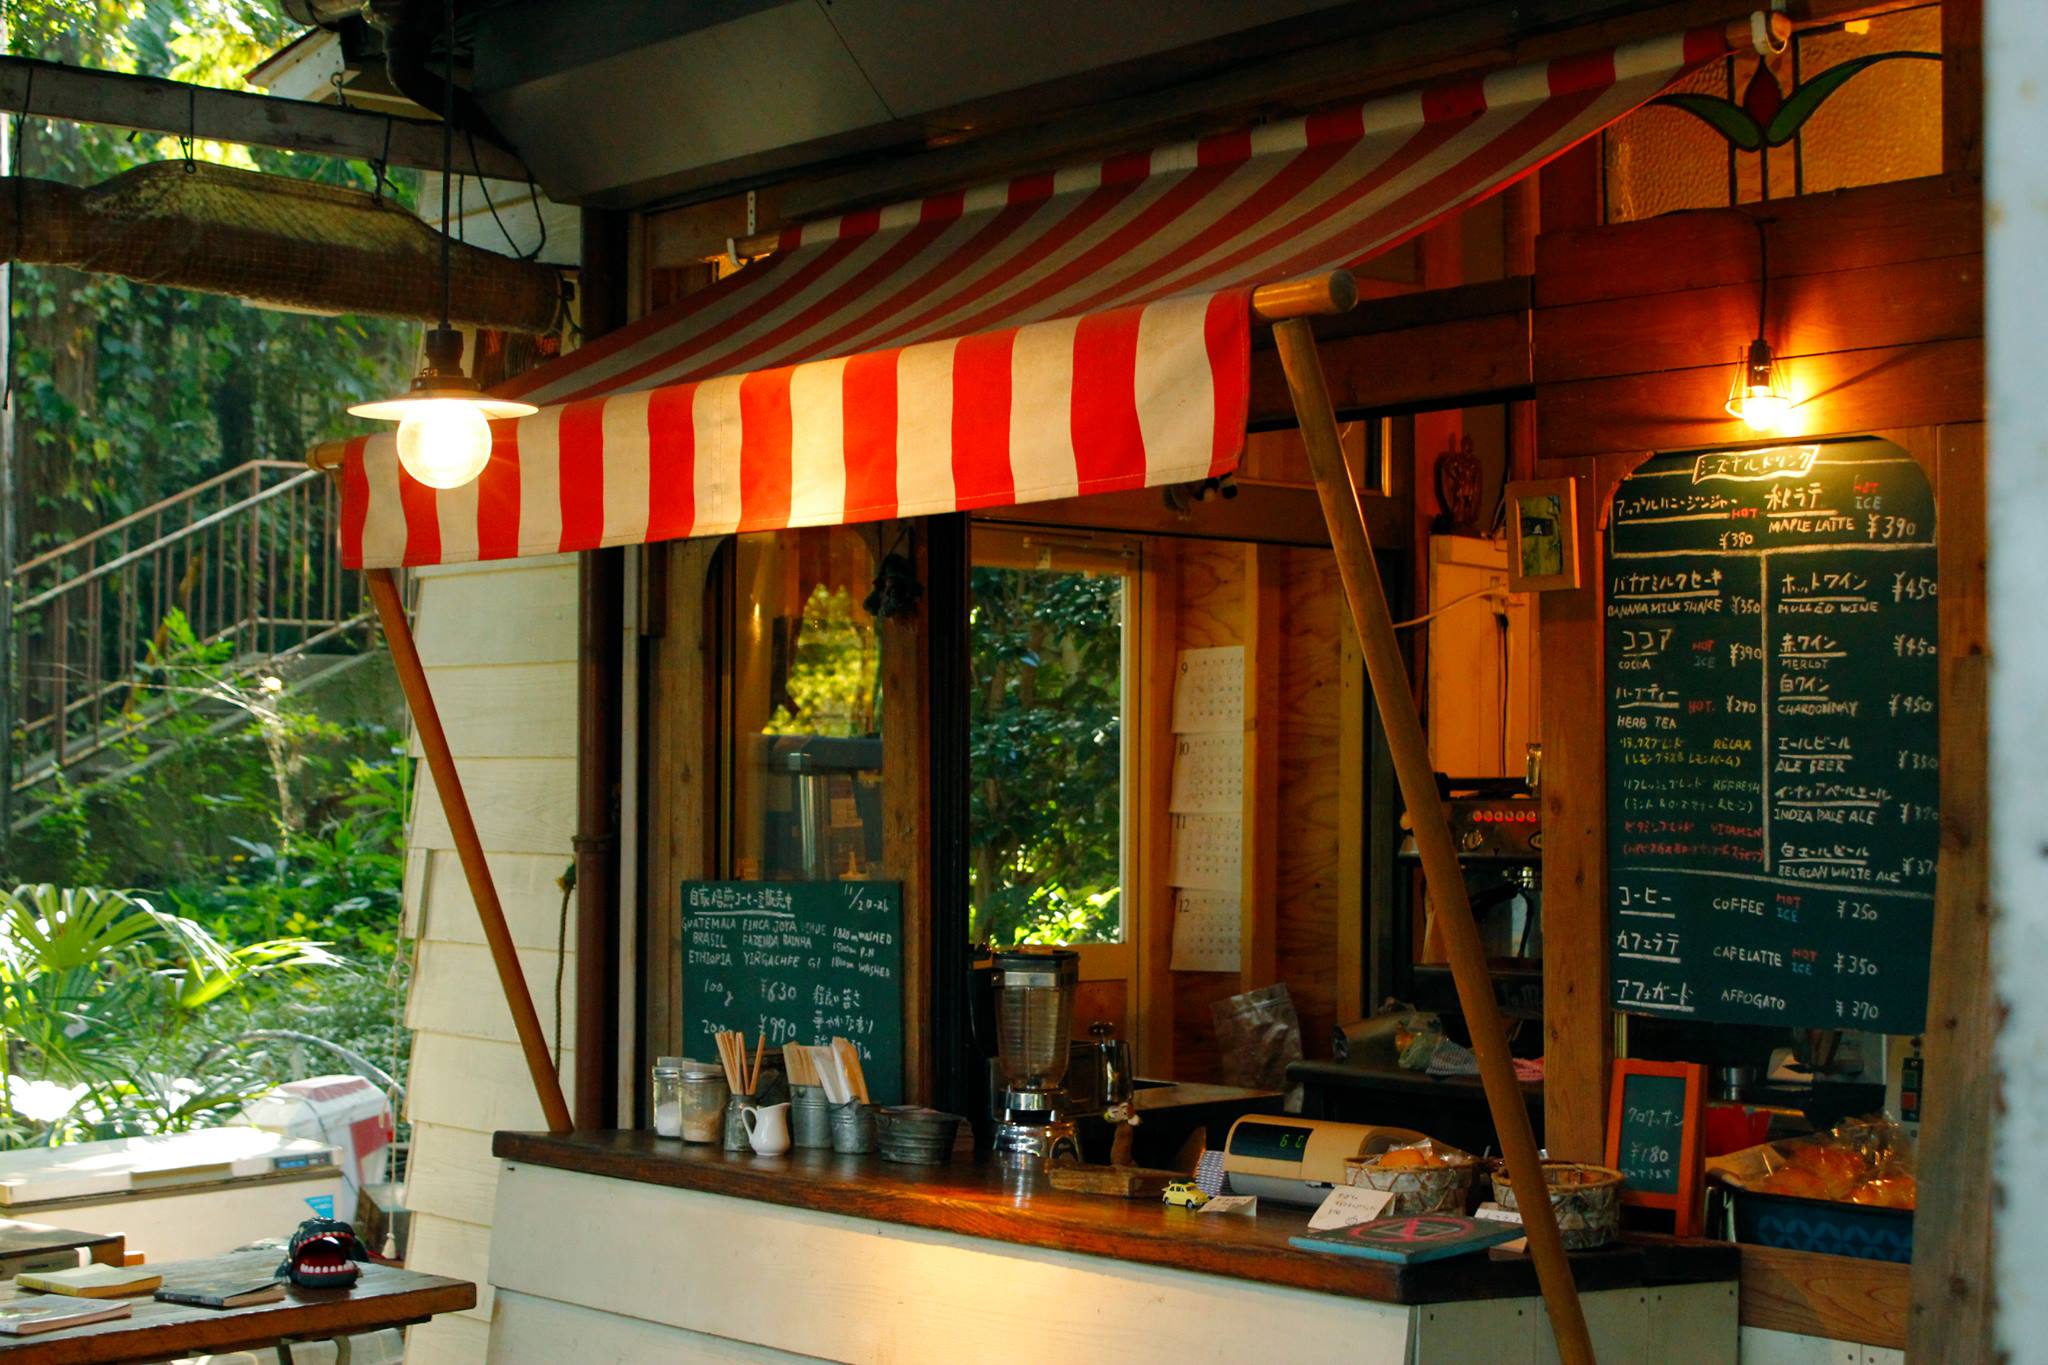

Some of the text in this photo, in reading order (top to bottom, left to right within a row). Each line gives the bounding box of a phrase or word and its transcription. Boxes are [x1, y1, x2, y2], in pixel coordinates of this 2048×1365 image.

[1854, 496, 1882, 510] ICE
[1731, 508, 1759, 520] HOT
[1768, 516, 1856, 534] MAPLE LATTE
[1866, 513, 1917, 539] ¥390
[1719, 531, 1754, 549] ¥390
[1613, 568, 1723, 594] バナナミルクセーキ
[1781, 571, 1868, 595] ホットワイン
[1777, 601, 1879, 615] MULLED WINE
[1622, 628, 1674, 651] ココア
[1692, 639, 1715, 652] HOT
[1780, 632, 1838, 653] 赤ワイン
[1781, 658, 1829, 670] MERLOT
[1780, 673, 1830, 693] 白ワイン
[1617, 715, 1678, 729] HERB TEA
[1713, 737, 1753, 750] RELAX
[1775, 759, 1846, 774] ALE BEER
[1773, 808, 1877, 826] INDIA PALE ALE
[1778, 864, 1901, 883] BELGIAN WHITE ALE
[1902, 857, 1937, 876] ¥37
[1618, 885, 1672, 906] コーヒー
[1178, 898, 1190, 913] 12
[1712, 897, 1765, 916] COFFEE
[1837, 899, 1878, 921] ¥250
[1776, 907, 1799, 923] ICE
[691, 933, 727, 948] BRASIL
[1616, 929, 1680, 954] カフェラテ
[688, 950, 733, 966] ETHIOPIA
[1833, 952, 1878, 975] ¥350
[1721, 988, 1787, 1011] AFFOGATO
